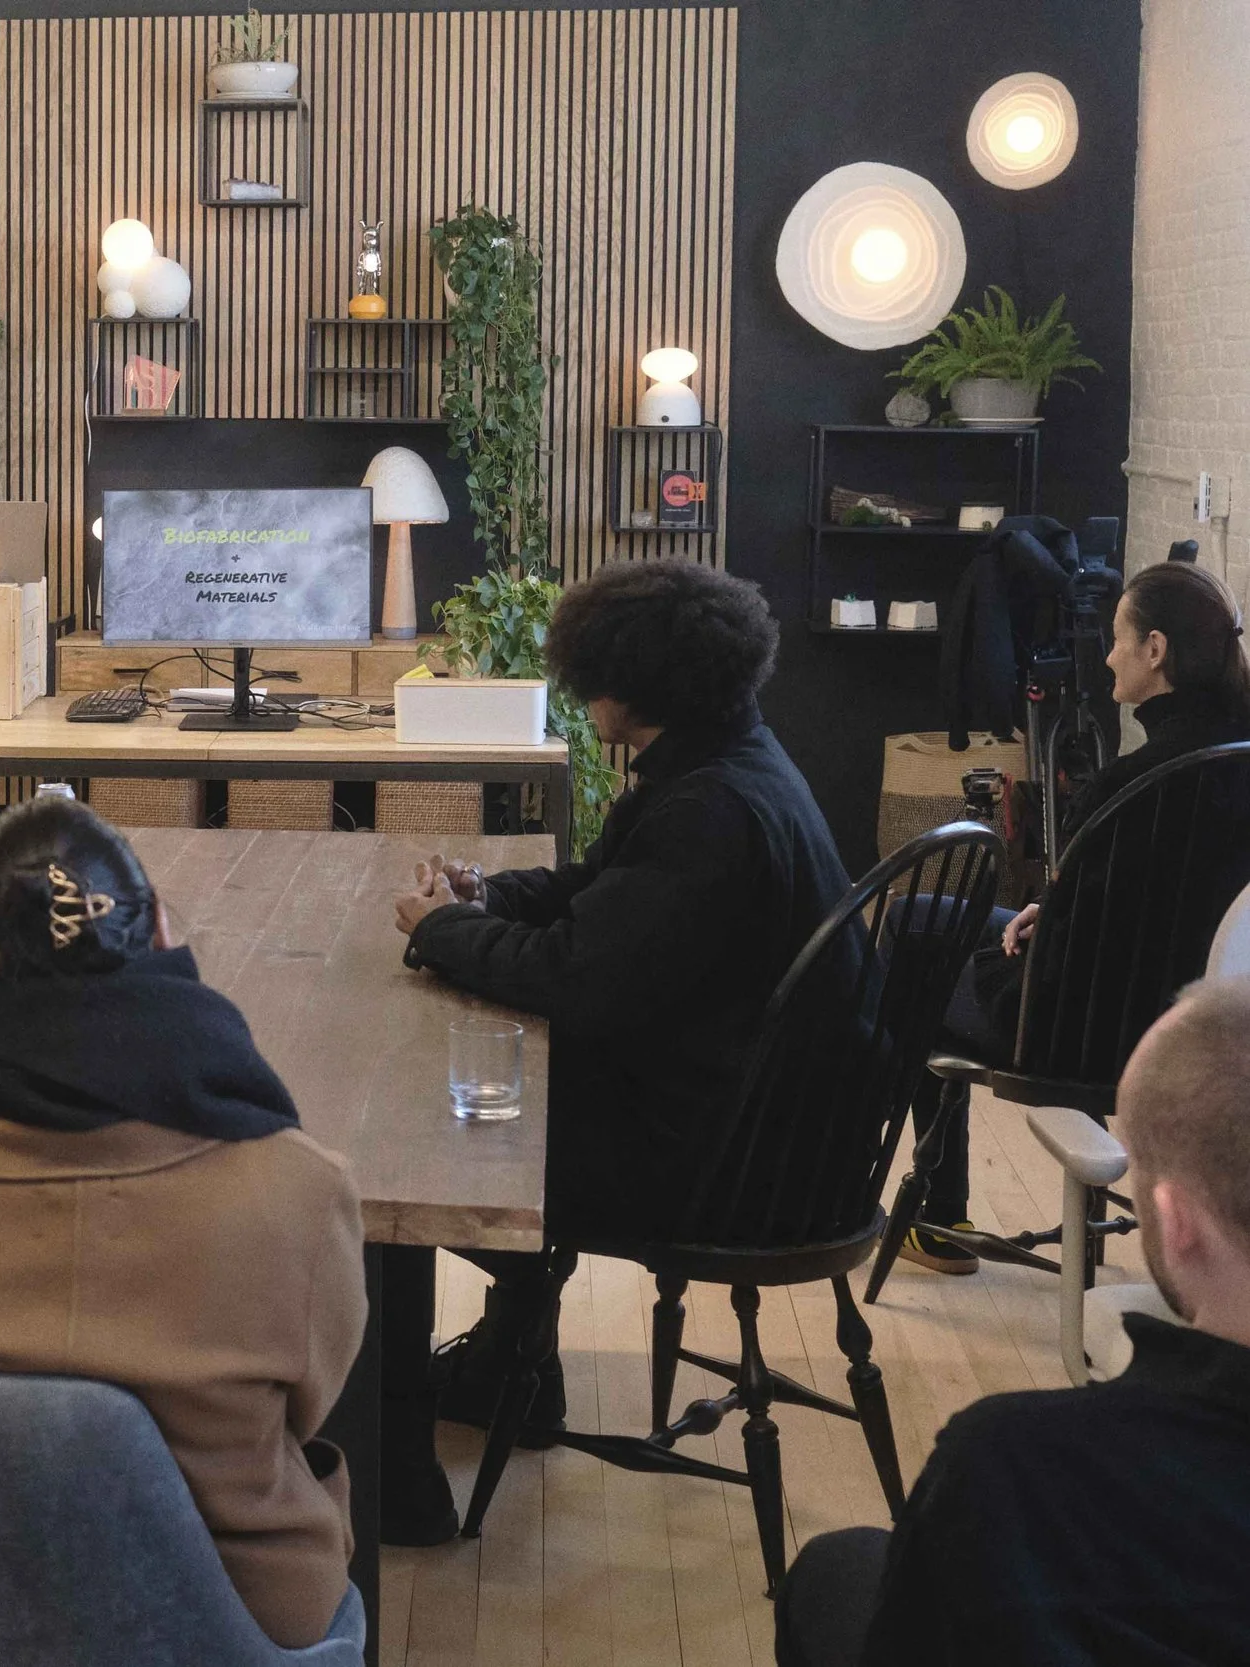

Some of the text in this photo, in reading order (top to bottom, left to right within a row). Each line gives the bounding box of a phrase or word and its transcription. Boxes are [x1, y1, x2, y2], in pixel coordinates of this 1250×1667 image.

[163, 528, 310, 544] BIOFABRICATION
[231, 554, 241, 564] +
[185, 570, 288, 584] REGENERATIVE
[196, 589, 278, 603] MATERIALS
